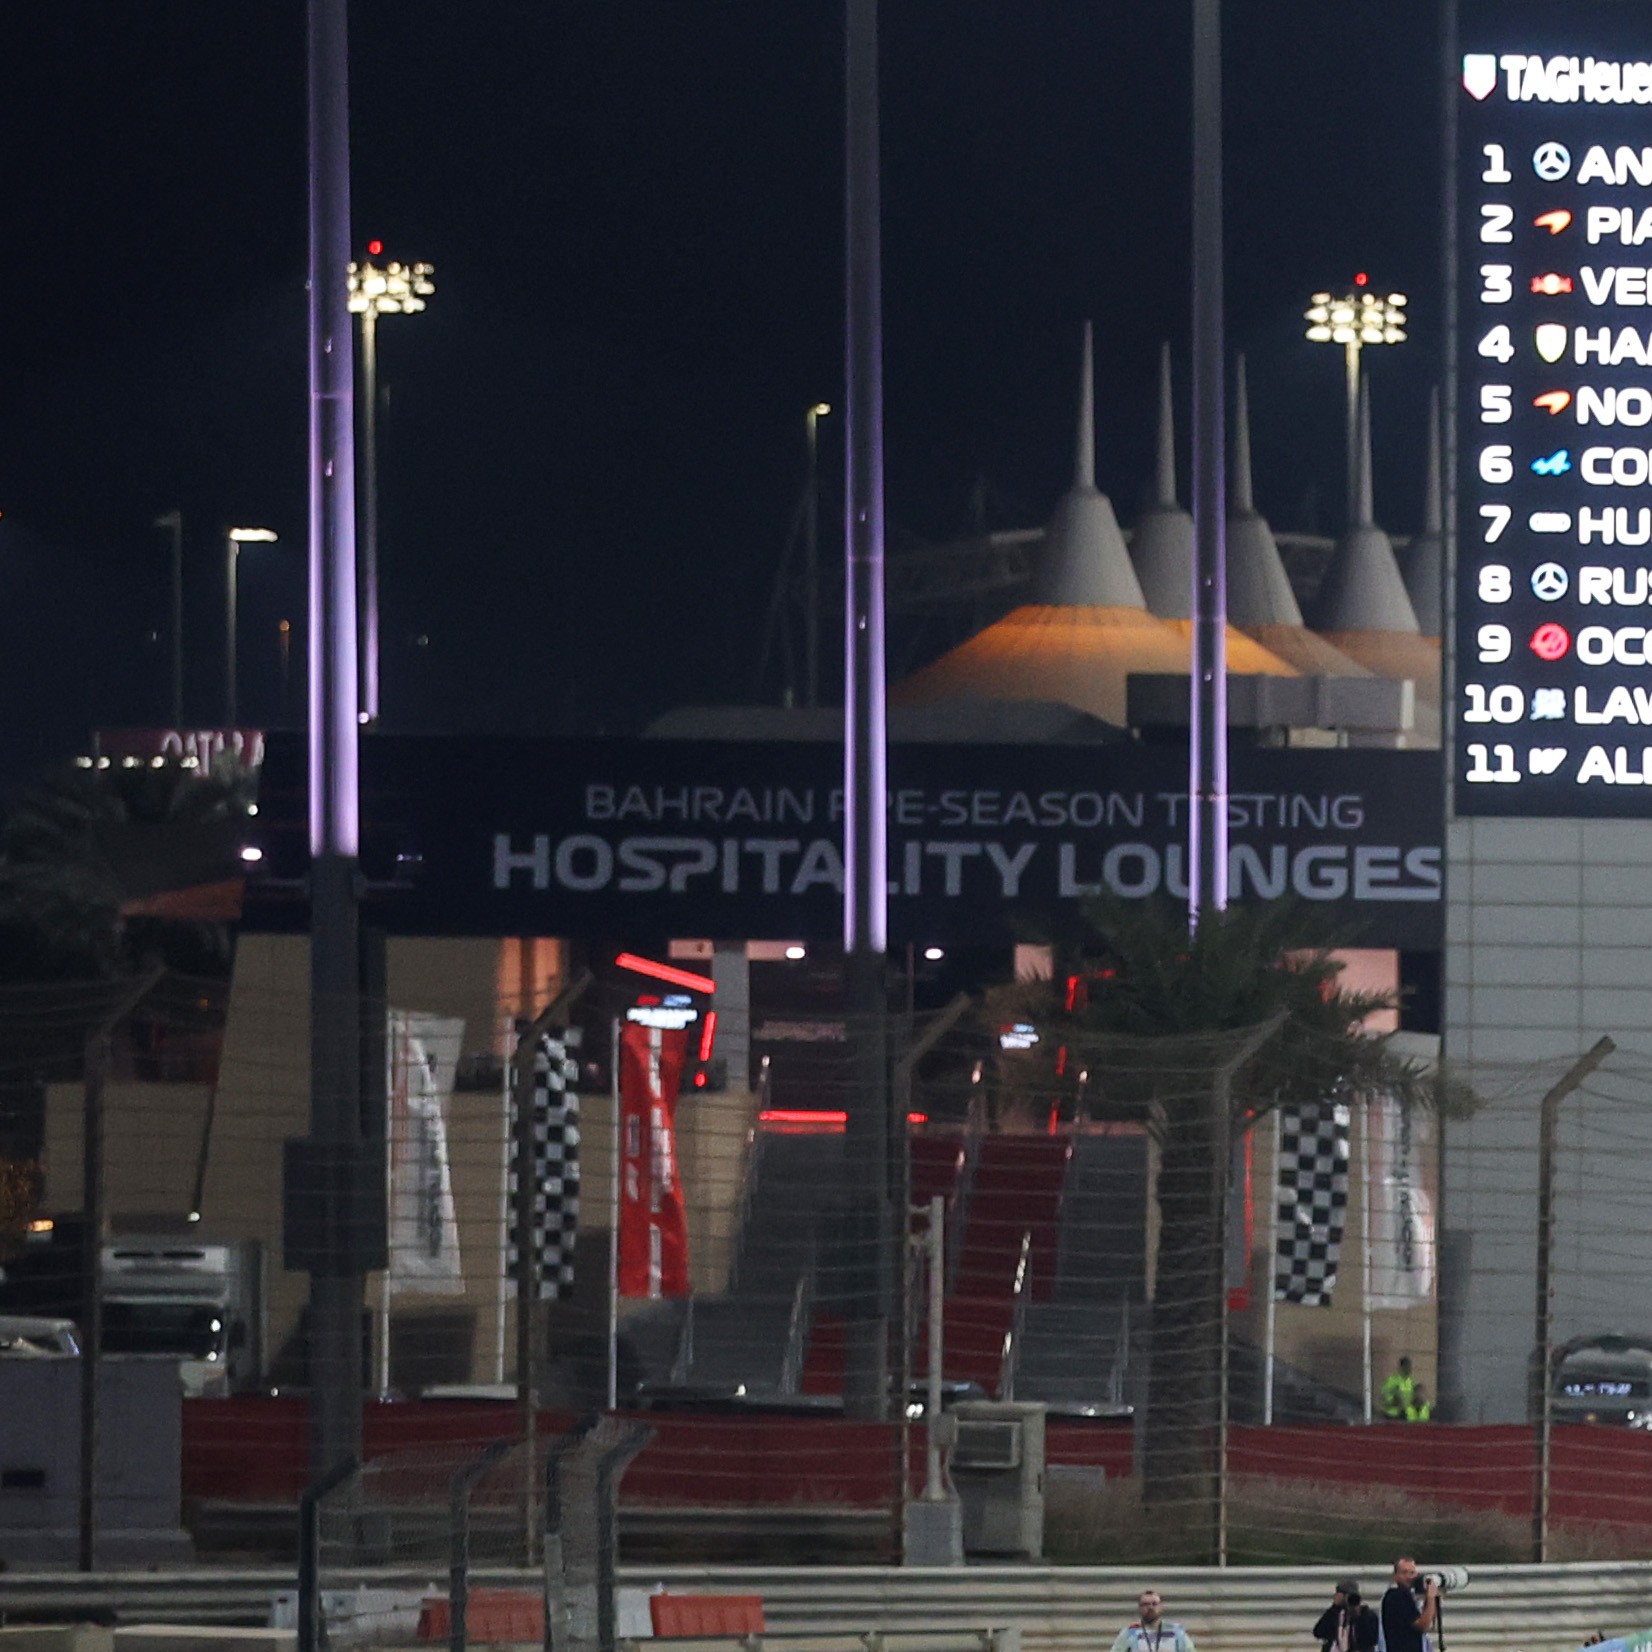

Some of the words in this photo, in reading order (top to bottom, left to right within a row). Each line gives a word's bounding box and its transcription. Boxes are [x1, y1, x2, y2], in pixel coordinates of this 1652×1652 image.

[1483, 145, 1511, 183] 1
[1481, 205, 1513, 243] 2
[1481, 265, 1512, 303] 3
[1478, 325, 1514, 363] 4
[1481, 385, 1511, 423] 5
[1480, 445, 1513, 484] 6
[1480, 505, 1511, 543] 7
[1479, 565, 1511, 603] 8
[1478, 625, 1511, 663] 9
[1464, 684, 1524, 724] 10
[1467, 744, 1521, 783] 11
[586, 784, 814, 823] BAHRAIN
[829, 790, 1143, 828] PE-SEASON
[1157, 793, 1364, 829] TSTING
[493, 834, 1037, 896] HOSPITAITY
